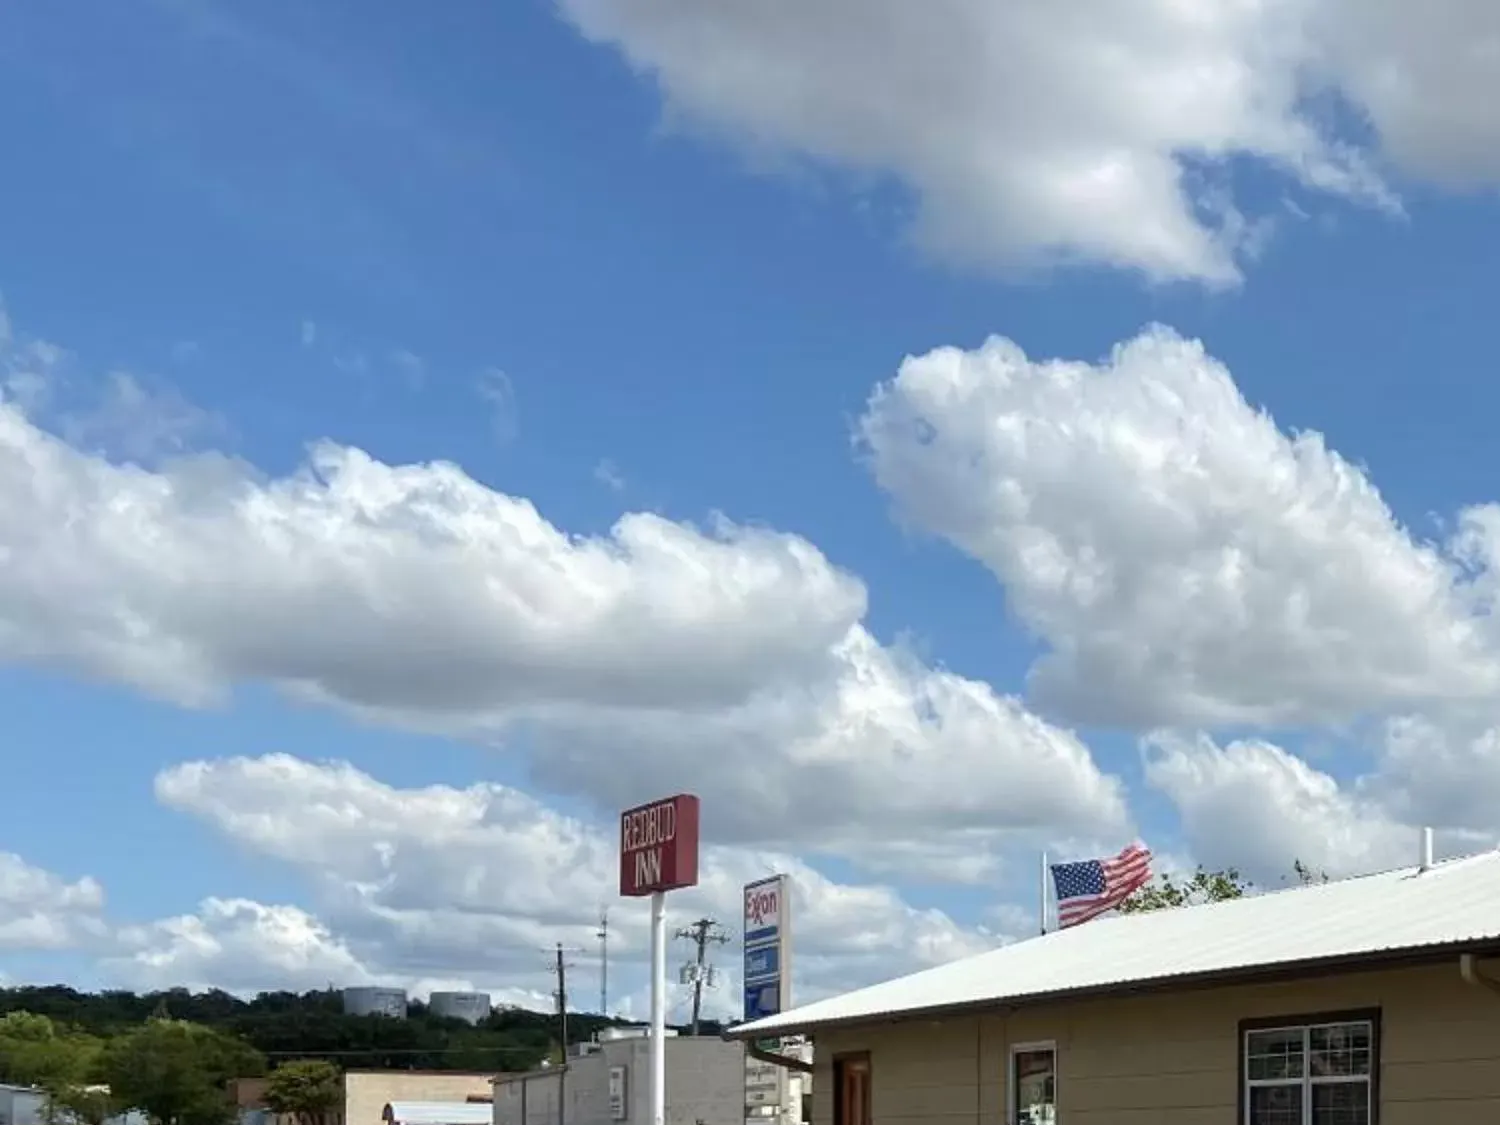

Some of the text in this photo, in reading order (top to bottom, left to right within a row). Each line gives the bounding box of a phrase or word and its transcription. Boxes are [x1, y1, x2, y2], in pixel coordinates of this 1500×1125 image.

[623, 803, 675, 853] REDBUD
[635, 847, 662, 888] INN
[746, 891, 777, 925] Exxon
